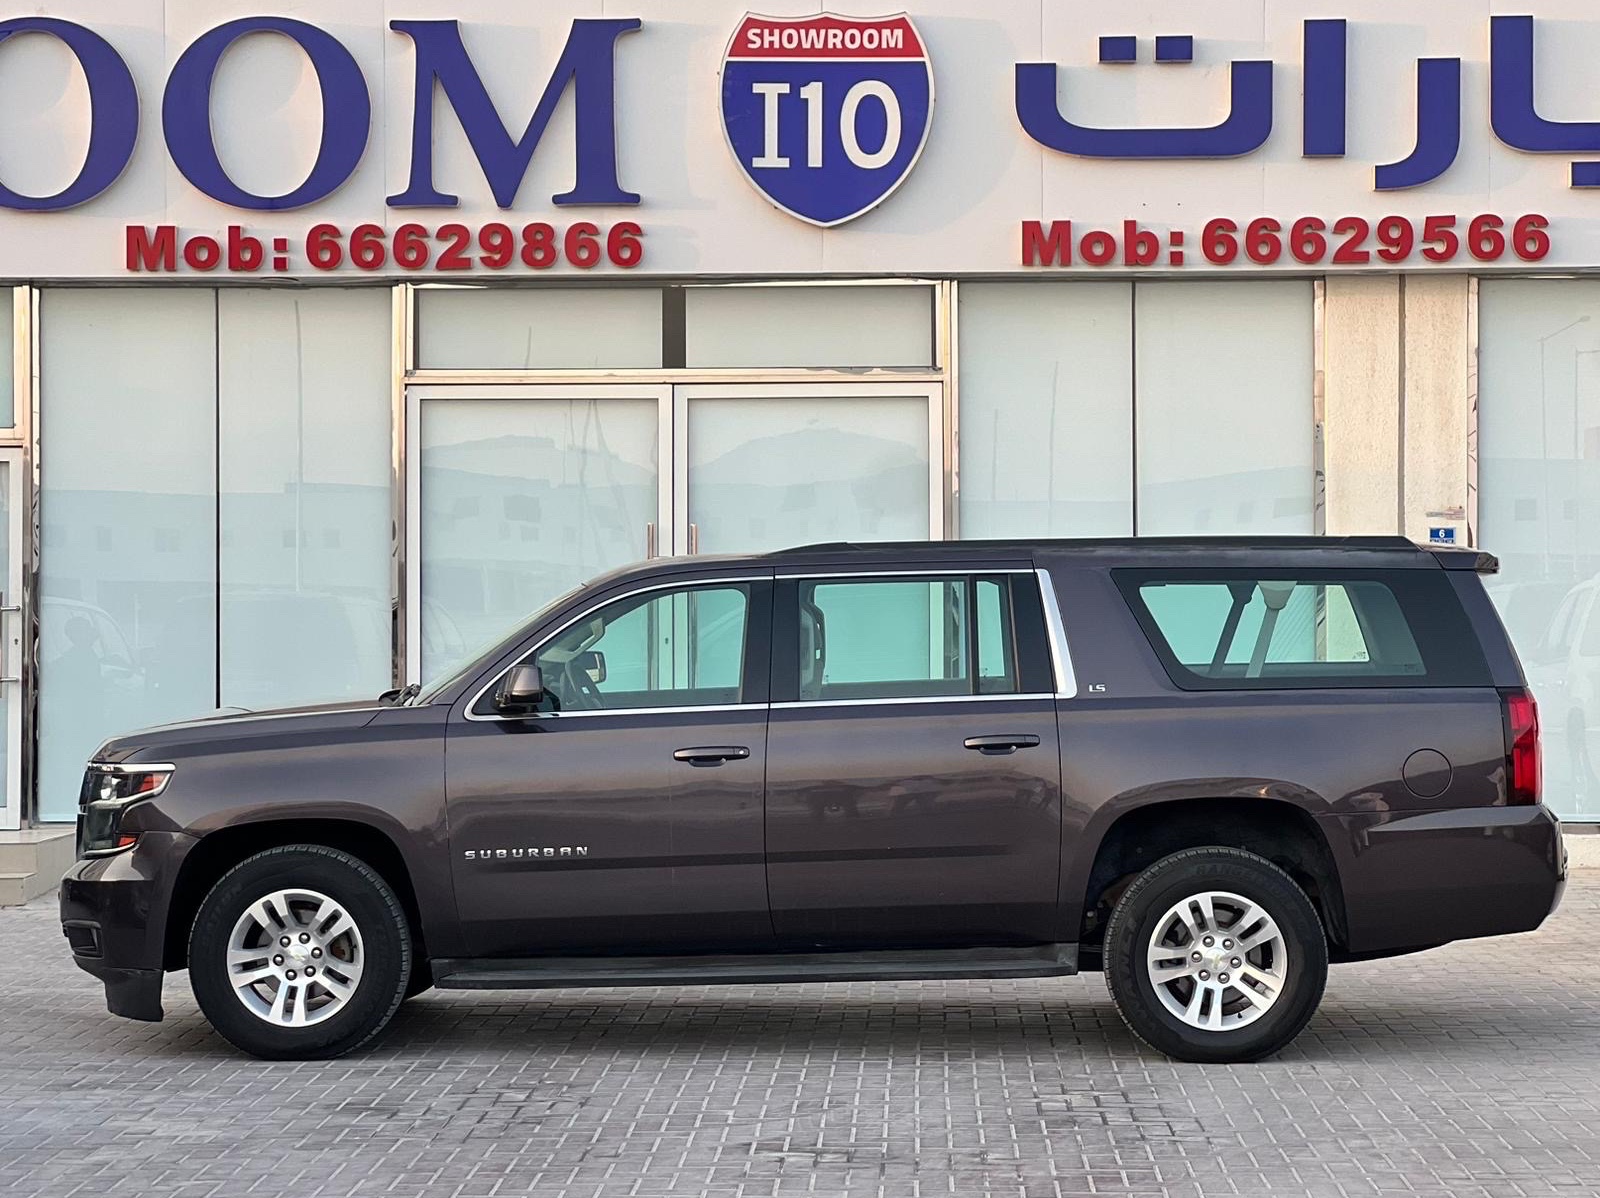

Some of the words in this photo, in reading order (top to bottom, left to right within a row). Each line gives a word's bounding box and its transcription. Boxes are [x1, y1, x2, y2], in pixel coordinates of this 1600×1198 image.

[746, 27, 904, 49] SHOWROOM
[752, 80, 902, 169] I10
[126, 225, 290, 271] Mob:
[305, 221, 643, 271] 66629866
[1022, 219, 1185, 266] Mob:
[1201, 213, 1551, 265] 66629566
[1439, 529, 1446, 538] 6
[1088, 684, 1106, 692] LS
[464, 846, 588, 860] SUBURBAN
